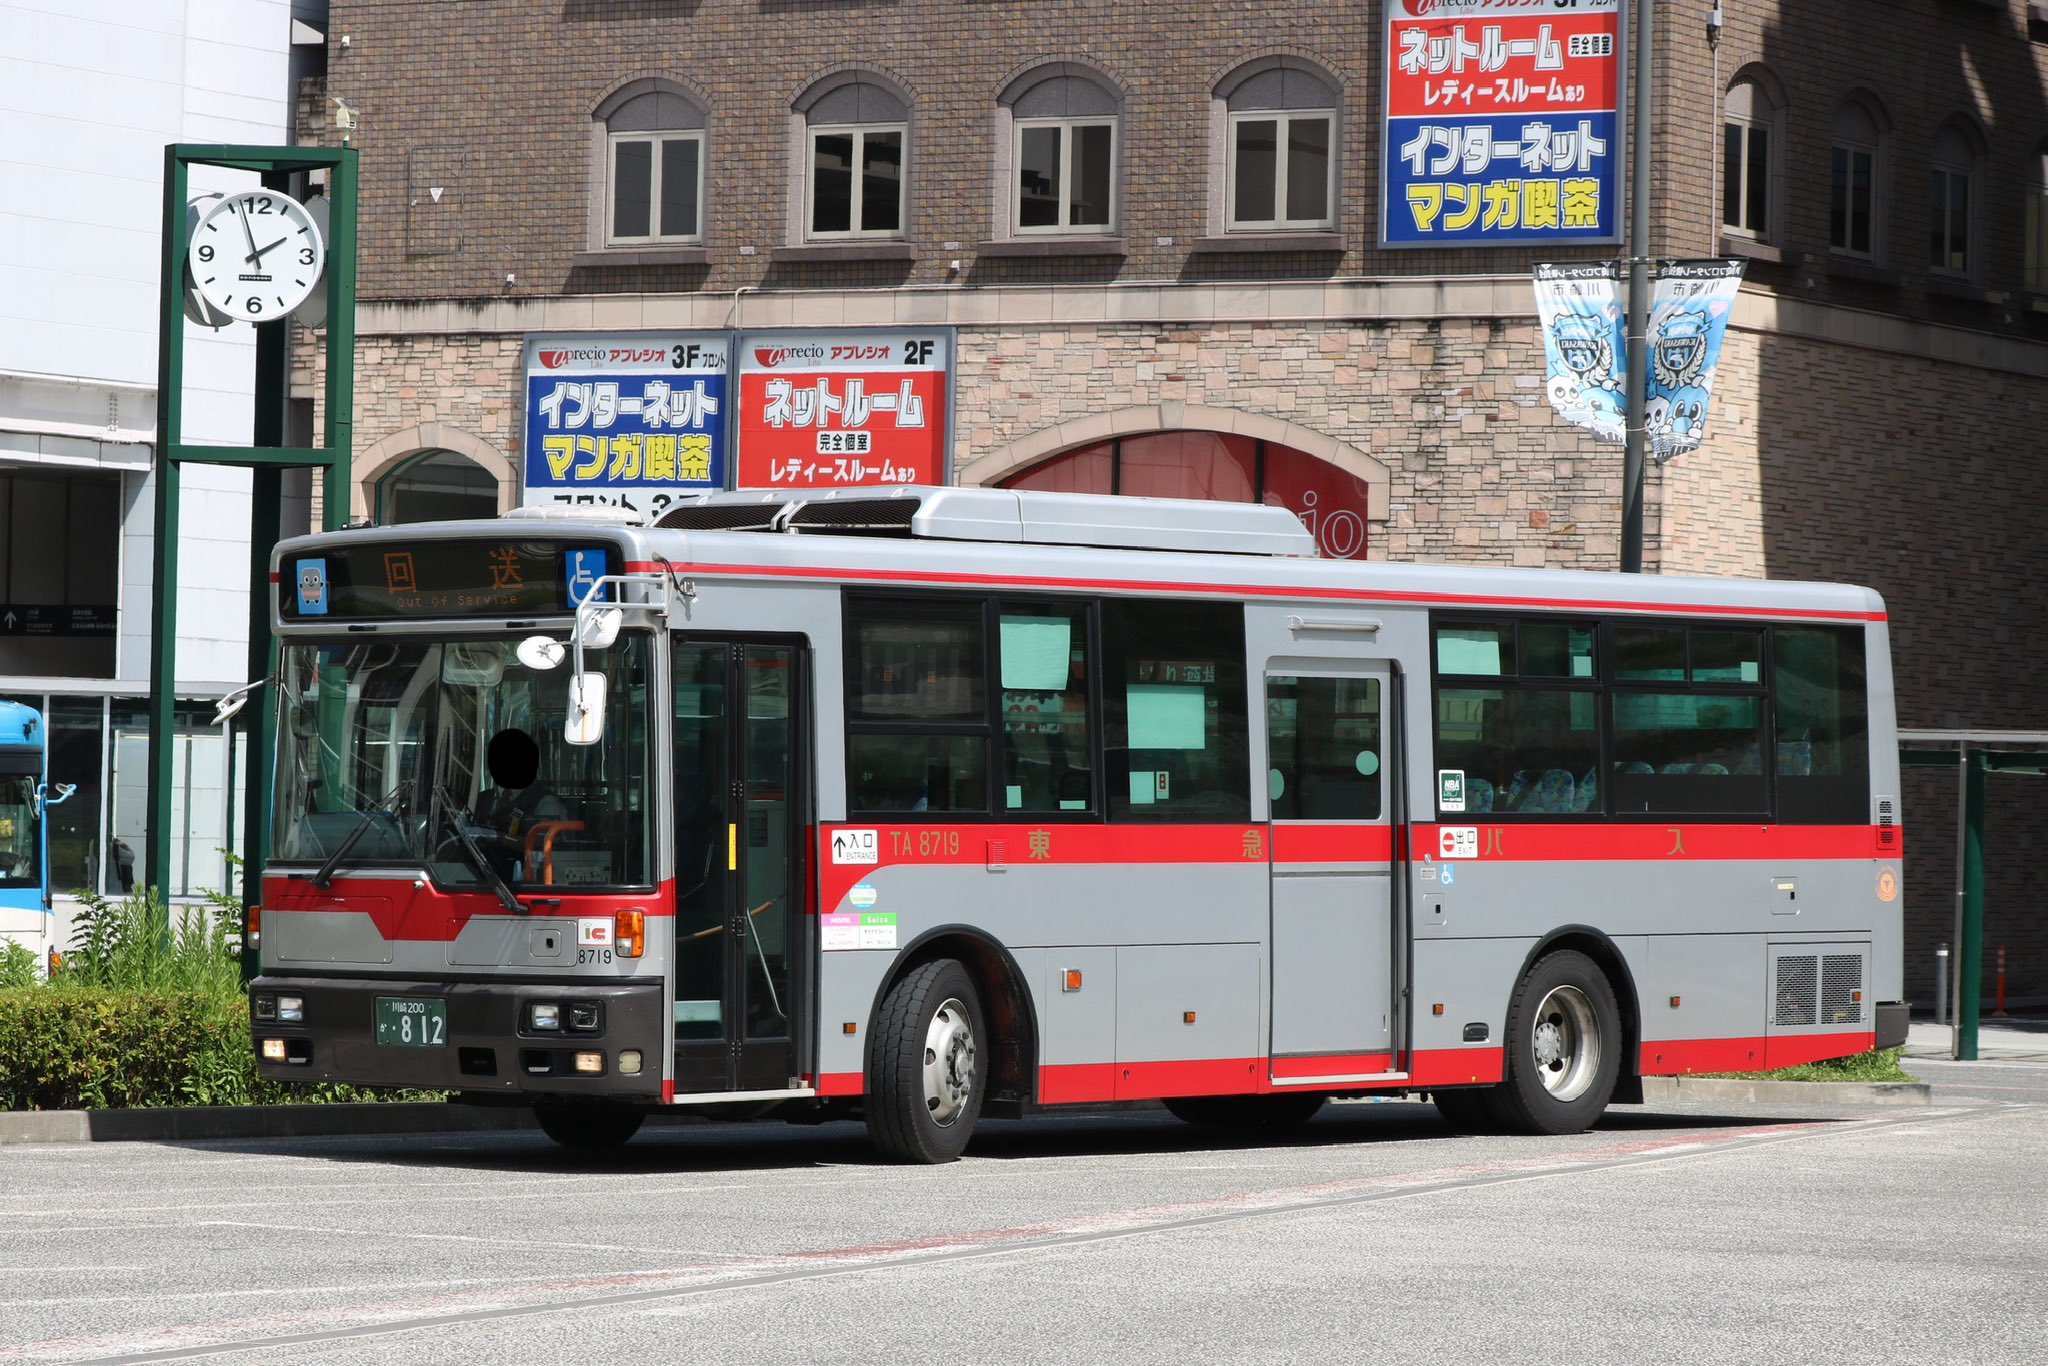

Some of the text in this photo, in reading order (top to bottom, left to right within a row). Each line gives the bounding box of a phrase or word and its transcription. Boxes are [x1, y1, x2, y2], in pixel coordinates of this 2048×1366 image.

[1399, 24, 1611, 74] ネットルーム 完全個室
[1424, 77, 1585, 106] レディースルームあり
[1401, 120, 1607, 175] インターネット
[243, 197, 272, 214] 12
[1406, 177, 1600, 232] マンガ喫茶
[198, 245, 215, 262] 9
[298, 248, 315, 265] 3
[246, 296, 263, 314] 6
[671, 345, 700, 369] 3F
[702, 353, 726, 368] フロント
[904, 341, 934, 365] 2F
[539, 380, 718, 429] インターネット
[763, 378, 926, 428] ネットルーム
[819, 433, 869, 452] 完全個室
[542, 433, 713, 482] マンガ喫茶
[770, 458, 916, 484] レディースルームあり
[383, 547, 524, 594] 回 送
[849, 833, 873, 849] 入口
[890, 831, 960, 856] TA 8719
[1027, 828, 1688, 860] 東 急 バ ス
[1456, 830, 1475, 845] 出口
[846, 851, 876, 861] ENTRANCE
[1458, 846, 1473, 856] EXIT
[578, 949, 612, 965] 8719
